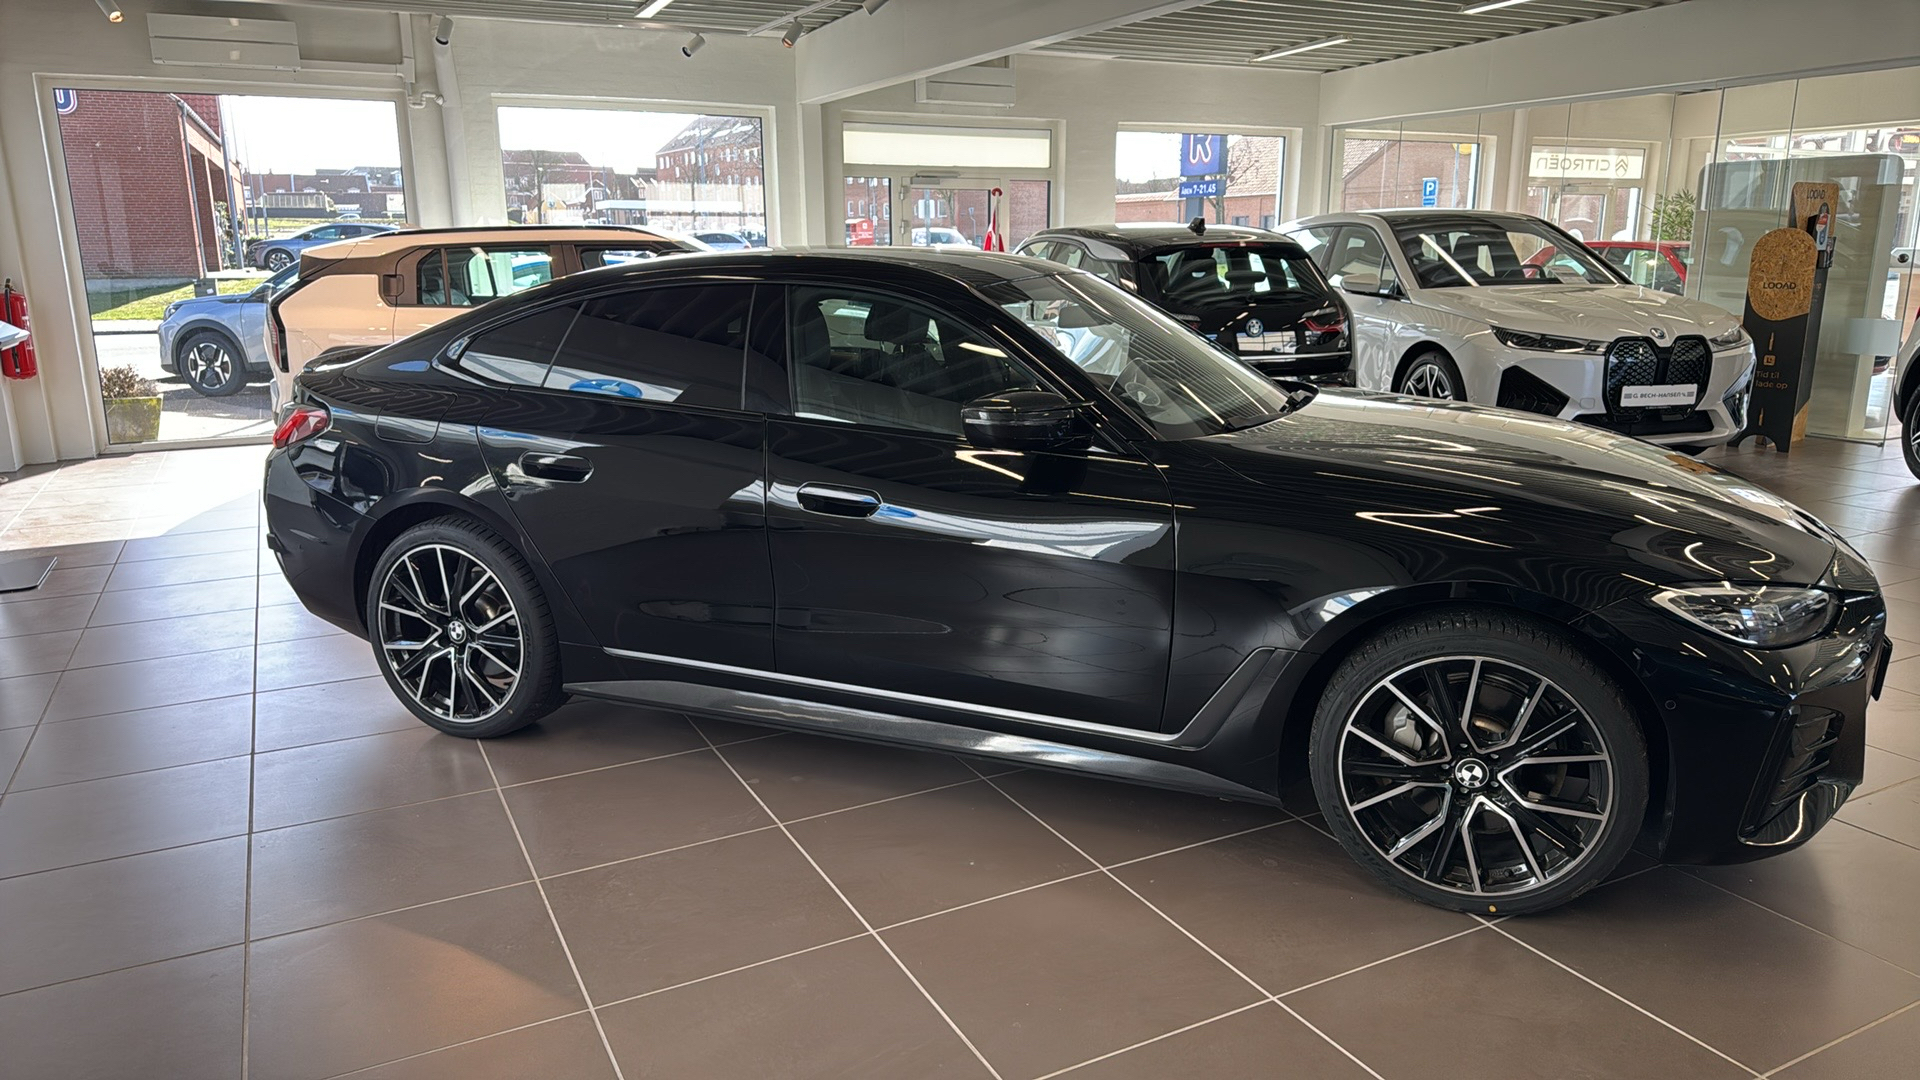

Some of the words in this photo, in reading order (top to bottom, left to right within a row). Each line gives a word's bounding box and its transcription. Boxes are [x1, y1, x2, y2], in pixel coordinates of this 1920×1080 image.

[1426, 182, 1435, 196] P
[1763, 282, 1797, 290] LOOAD
[1756, 370, 1769, 379] Tid
[1755, 380, 1774, 389] lade
[1776, 382, 1788, 390] op
